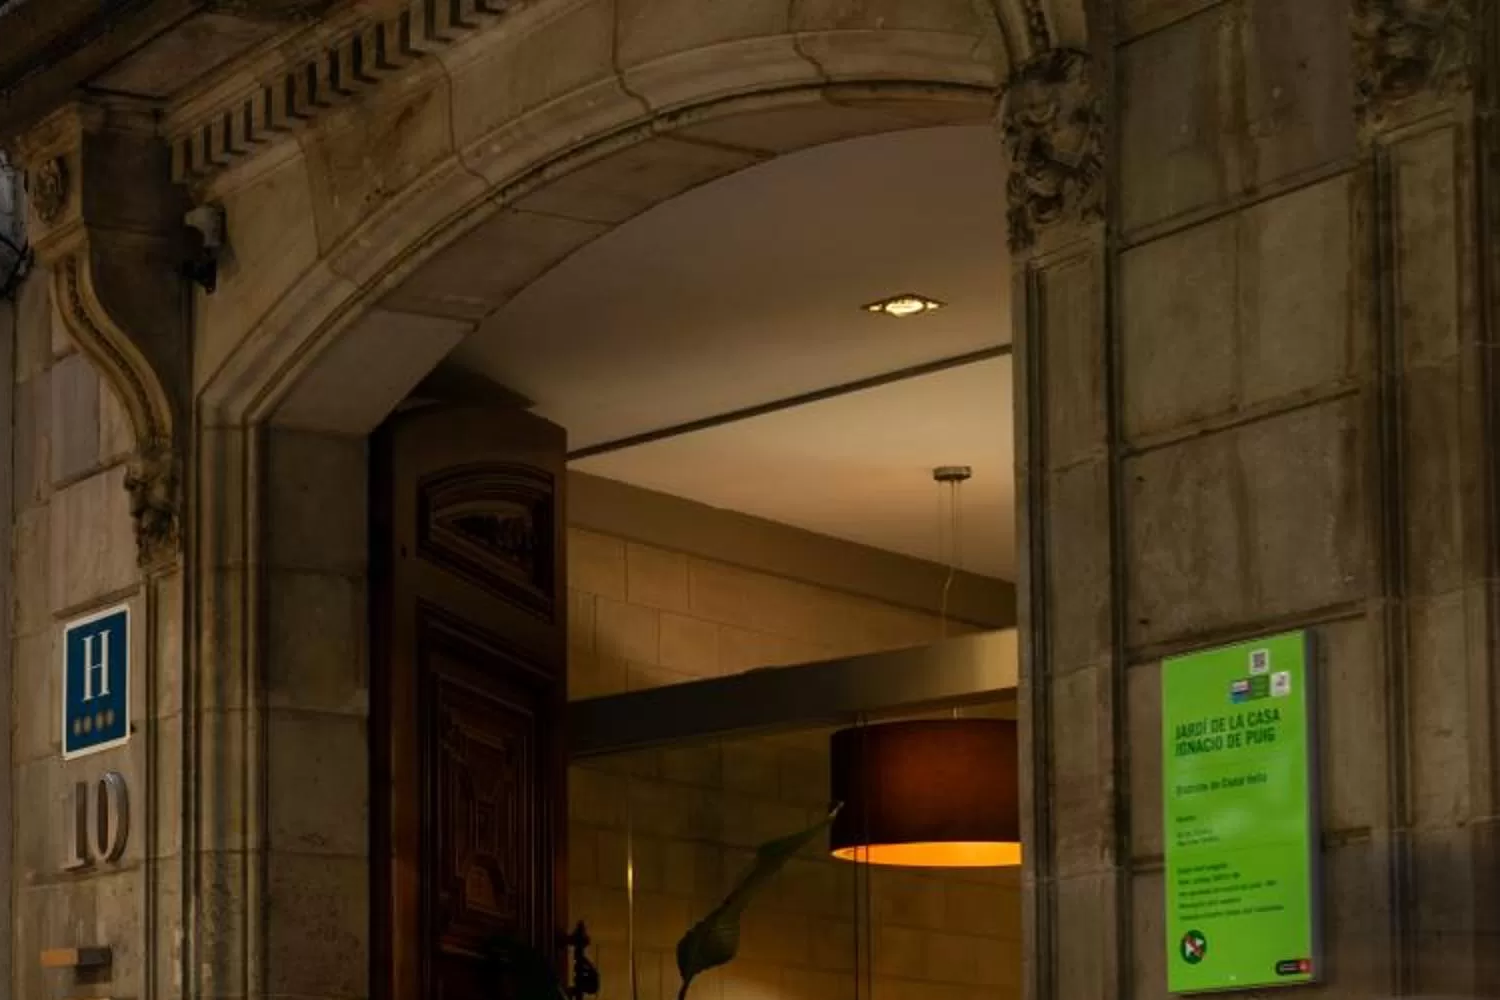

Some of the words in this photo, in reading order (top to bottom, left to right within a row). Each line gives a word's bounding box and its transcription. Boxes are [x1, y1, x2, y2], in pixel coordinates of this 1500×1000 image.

[82, 628, 113, 701] H
[1175, 715, 1207, 740] JARDÍ
[1211, 718, 1226, 734] DE
[1229, 712, 1245, 730] LA
[1247, 707, 1281, 727] CASA
[1175, 735, 1222, 756] IGNACIO
[1227, 732, 1241, 749] DE
[1246, 727, 1276, 746] PUIG
[60, 770, 130, 873] 10
